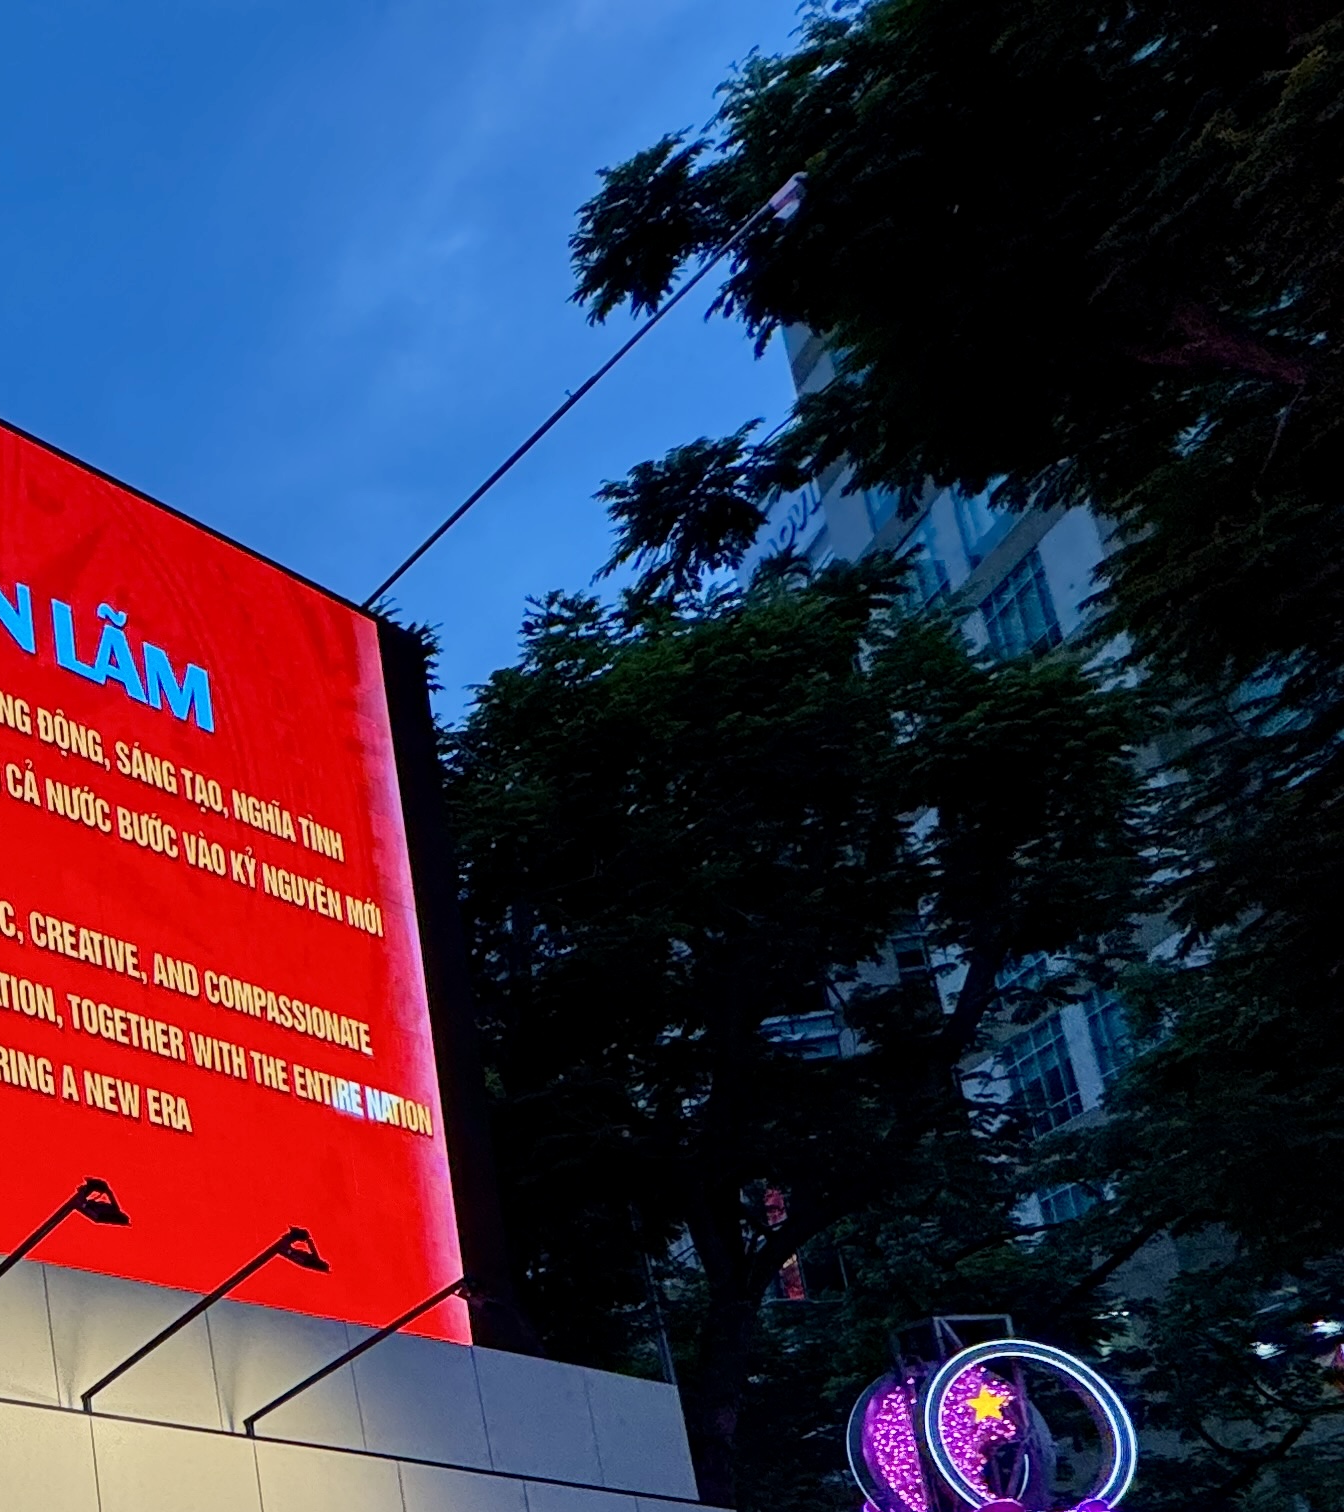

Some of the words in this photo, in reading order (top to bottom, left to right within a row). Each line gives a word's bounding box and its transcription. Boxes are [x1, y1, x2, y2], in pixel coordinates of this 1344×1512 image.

[51, 599, 214, 732] LÃM
[6, 760, 40, 806] CẢ
[46, 779, 111, 832] NƯỚC
[117, 807, 178, 857] BƯỚC
[183, 832, 226, 875] VÀO
[231, 847, 255, 887] KỶ
[263, 863, 342, 920] NGUYÊN
[346, 896, 383, 936] MỚI
[37, 708, 110, 770] ĐỘNG,
[116, 742, 177, 793] SÁNG
[181, 768, 228, 818] TẠO,
[233, 790, 296, 842] NGHĨA
[298, 815, 343, 861] TÌNH
[30, 912, 147, 984] CREATIVE,
[154, 953, 199, 996] AND
[205, 971, 373, 1055] COMPASSIONATE
[63, 1065, 79, 1101] A
[84, 1071, 139, 1117] NEW
[147, 1088, 192, 1132] ERA
[67, 994, 185, 1060] TOGETHER
[190, 1032, 247, 1079] WITH
[250, 1051, 289, 1092] THE
[294, 1064, 364, 1117] ENTIRE
[365, 1086, 432, 1135] NATION
